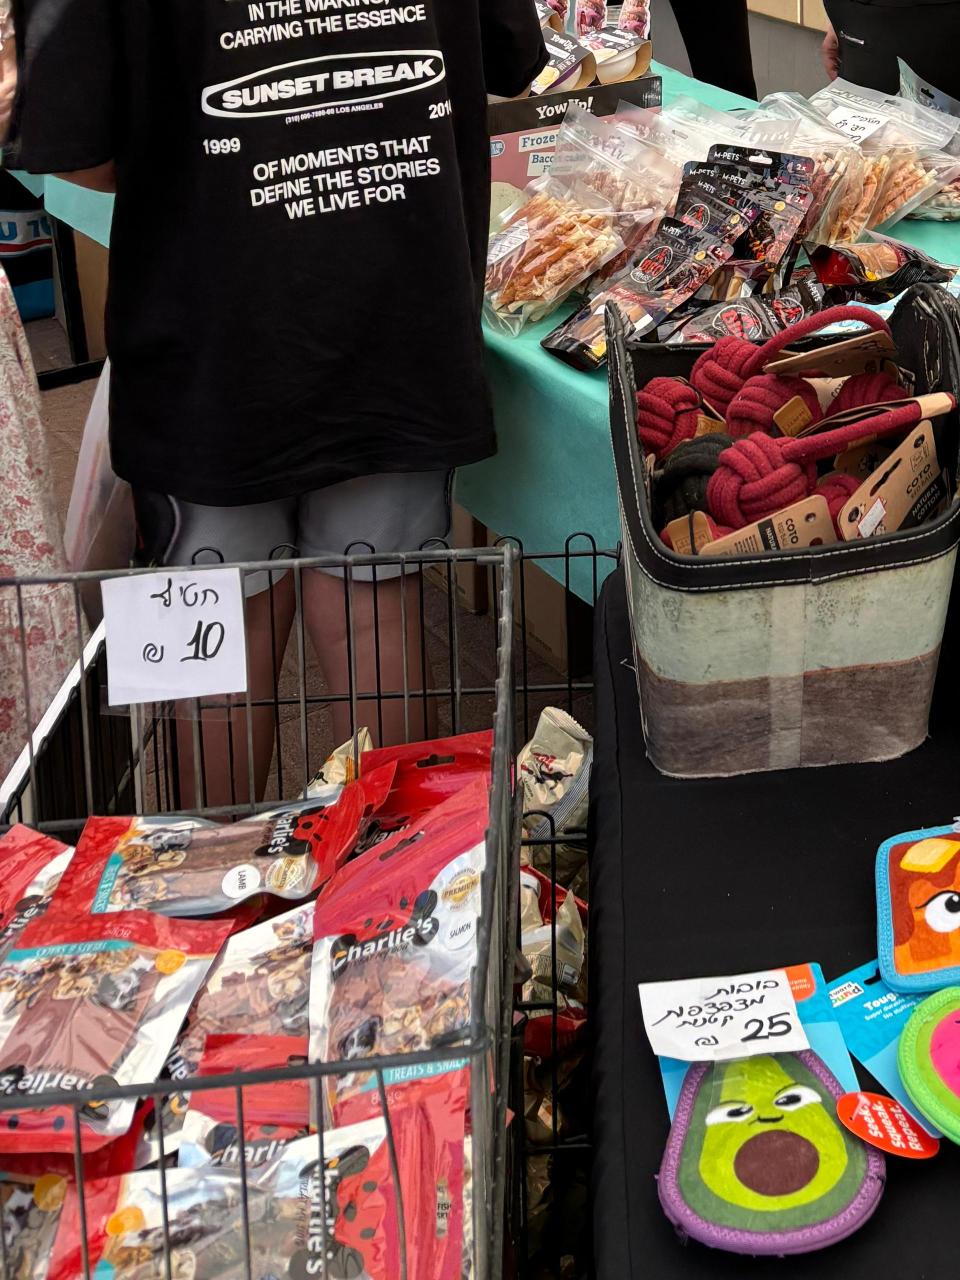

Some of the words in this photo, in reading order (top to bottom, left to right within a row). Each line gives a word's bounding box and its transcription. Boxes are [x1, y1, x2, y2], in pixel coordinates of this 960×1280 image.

[248, 3, 265, 21] IN
[219, 23, 303, 50] CARRYING
[305, 15, 342, 35] THE
[345, 4, 426, 30] ESSENCE
[221, 73, 330, 110] SUNSET
[333, 59, 437, 90] BREAK
[203, 137, 241, 156] 1999
[522, 134, 558, 149] Froze
[253, 161, 278, 182] OF
[280, 144, 378, 177] MOMENTS
[380, 135, 431, 159] THAT
[714, 151, 740, 161] M-PETS
[251, 181, 312, 207] DEFINE
[314, 172, 354, 192] THE
[357, 158, 441, 185] STORIES
[722, 173, 747, 185] M-PETS
[284, 200, 317, 220] WE
[320, 192, 361, 213] LIVE
[365, 184, 406, 205] FOR
[905, 463, 931, 495] COTO
[912, 483, 939, 517] NATURAL
[917, 491, 941, 521] COTTON
[785, 518, 799, 545] COTO
[180, 620, 225, 662] 10
[237, 870, 247, 891] LAMB
[449, 921, 472, 939] SALMON
[705, 980, 779, 1001] בובות
[863, 992, 897, 1011] Toug
[741, 1012, 792, 1043] 25
[389, 1065, 424, 1081] TREATS
